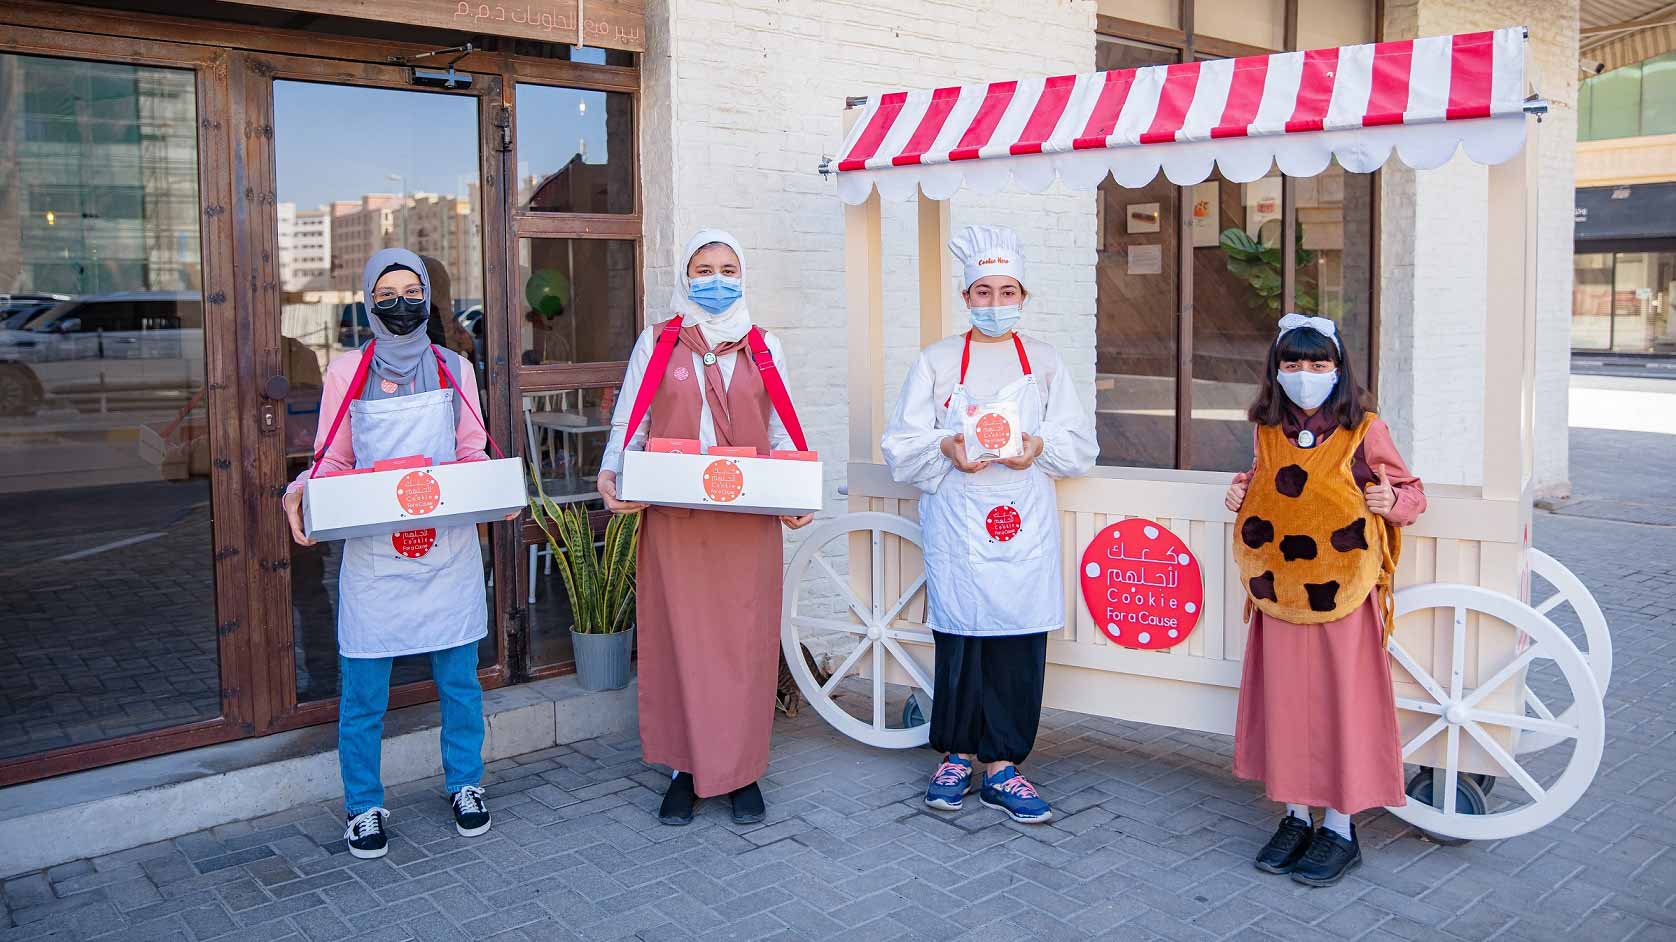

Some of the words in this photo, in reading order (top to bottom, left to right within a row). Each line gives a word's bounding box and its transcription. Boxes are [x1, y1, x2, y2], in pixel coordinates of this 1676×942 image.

[1107, 541, 1178, 564] كعك
[1107, 566, 1178, 588] لأجلهم
[1107, 587, 1178, 609] Cookie
[1107, 607, 1126, 621] For
[1138, 611, 1178, 627] Cause
